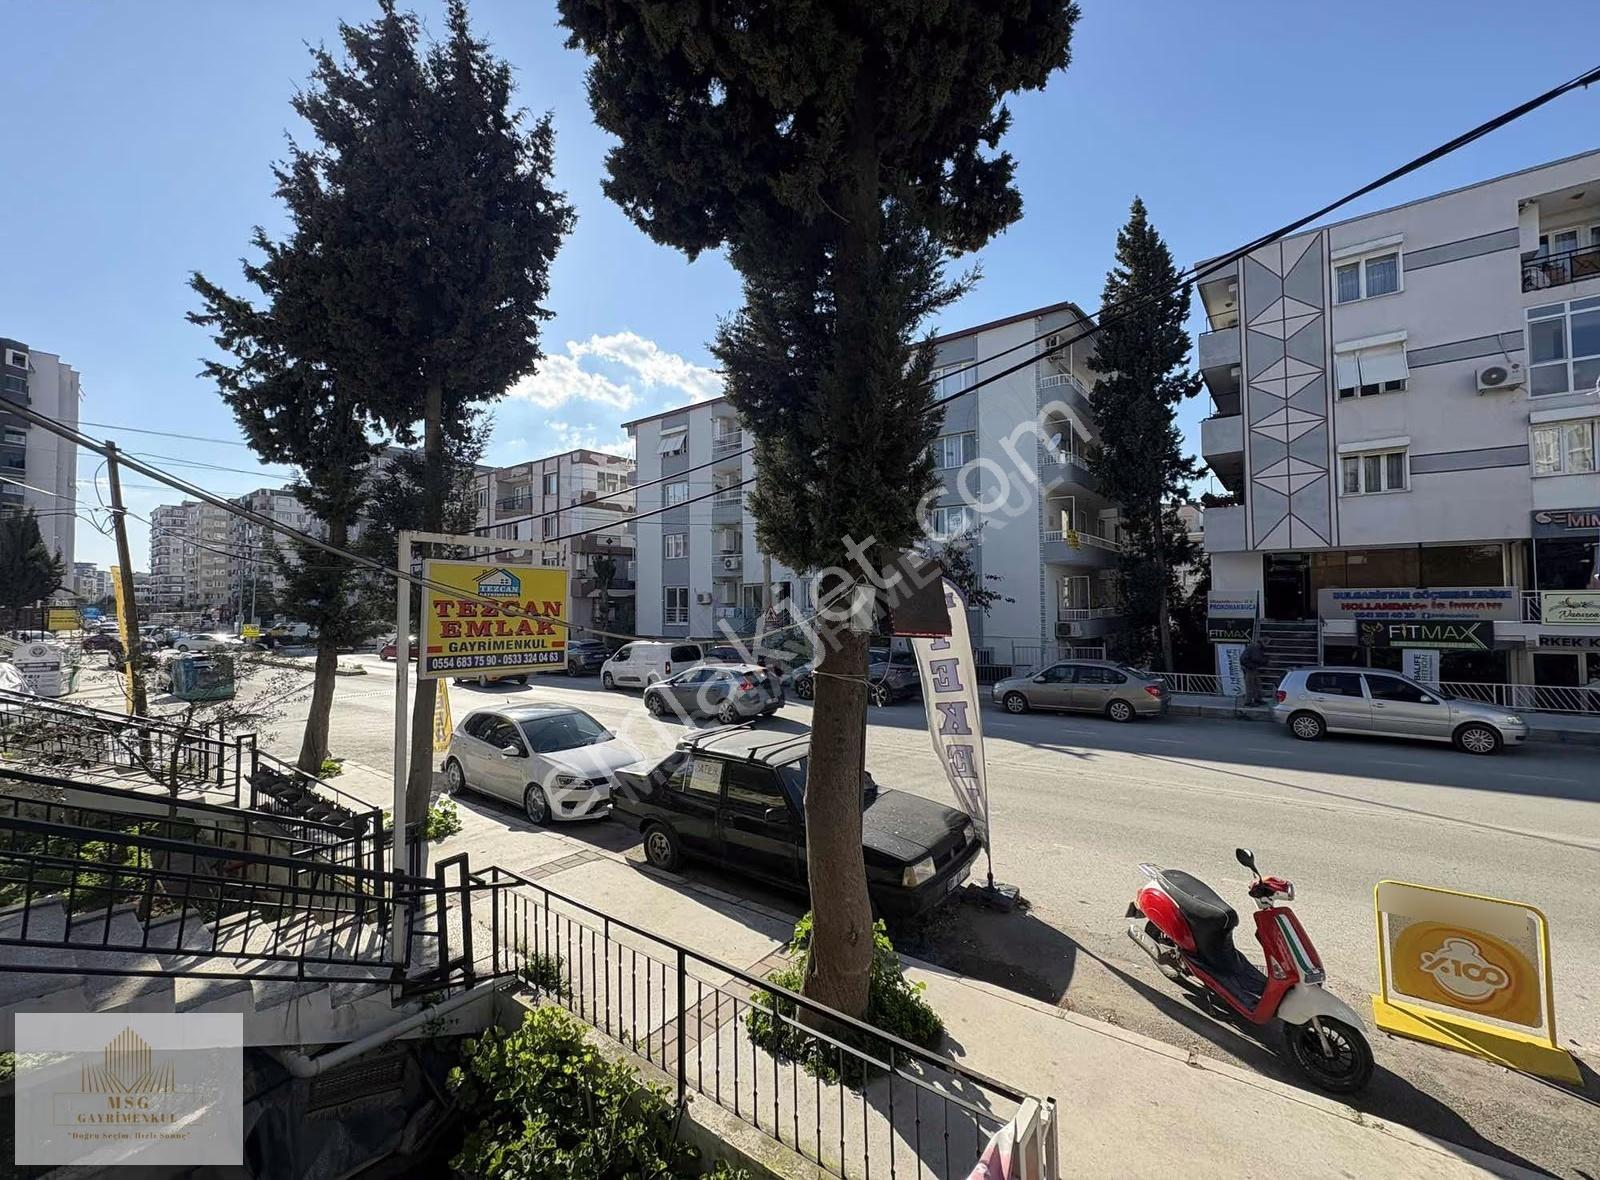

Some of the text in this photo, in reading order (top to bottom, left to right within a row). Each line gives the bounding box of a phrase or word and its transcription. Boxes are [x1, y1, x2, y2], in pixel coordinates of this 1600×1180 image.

[479, 585, 519, 593] TEZCAN
[432, 599, 563, 618] TEZCAN
[439, 619, 557, 639] EMLAK
[1209, 629, 1251, 639] FITMAX
[448, 638, 548, 653] GAYRİMENKUL
[432, 657, 455, 669] 0554
[456, 656, 472, 668] 683
[474, 655, 485, 666] 75
[486, 654, 496, 665] 90
[503, 653, 521, 665] 0533
[523, 653, 537, 663] 324
[538, 652, 548, 662] 04
